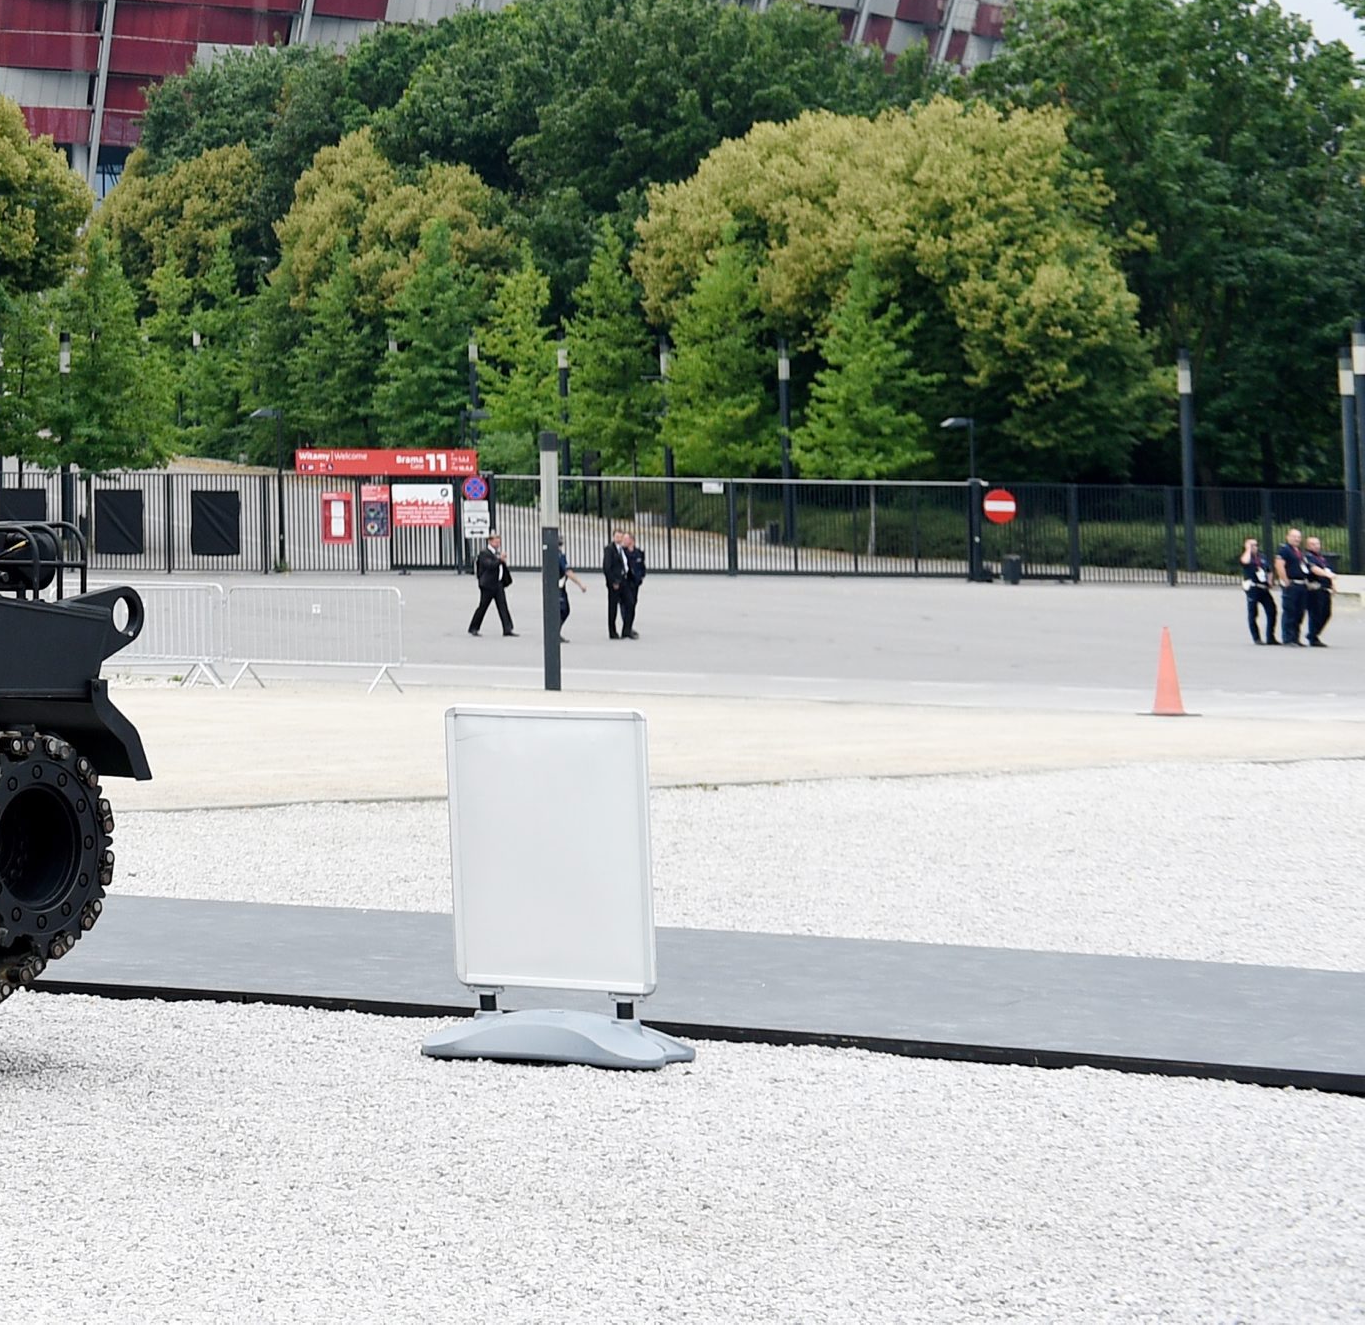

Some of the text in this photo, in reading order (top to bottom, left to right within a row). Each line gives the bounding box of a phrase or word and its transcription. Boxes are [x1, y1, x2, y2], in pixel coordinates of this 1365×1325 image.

[298, 451, 368, 462] Witamy Welcome
[395, 455, 424, 464] Brama
[425, 453, 447, 472] 11
